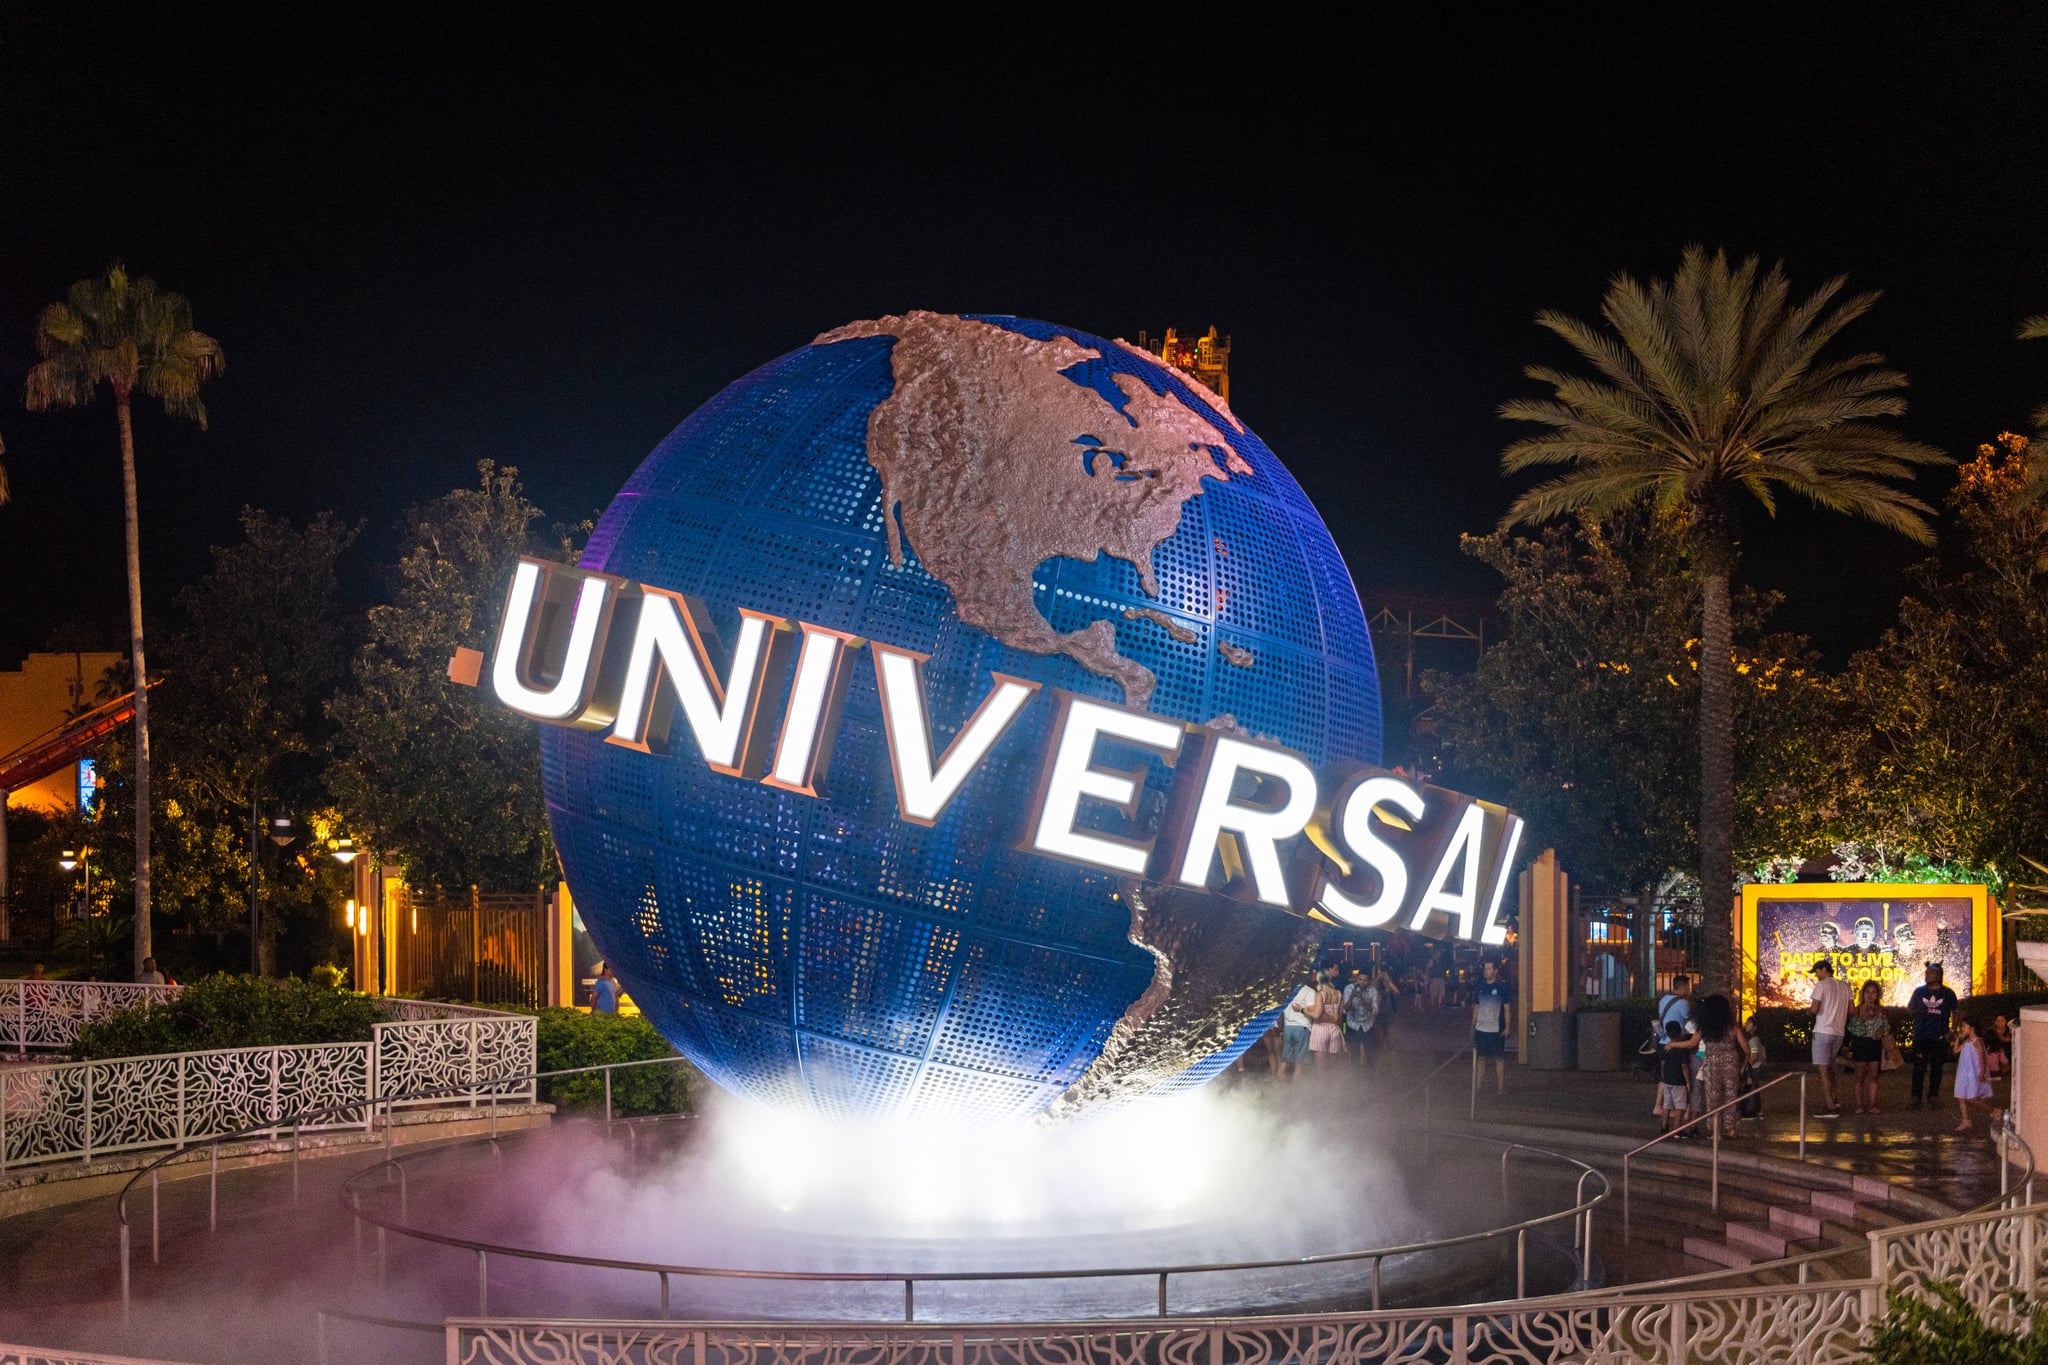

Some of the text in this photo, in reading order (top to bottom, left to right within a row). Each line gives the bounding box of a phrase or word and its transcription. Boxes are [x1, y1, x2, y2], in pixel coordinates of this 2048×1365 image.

[491, 556, 1526, 947] UNIVERSAL
[1780, 952, 1894, 967] DARE TO LIVE
